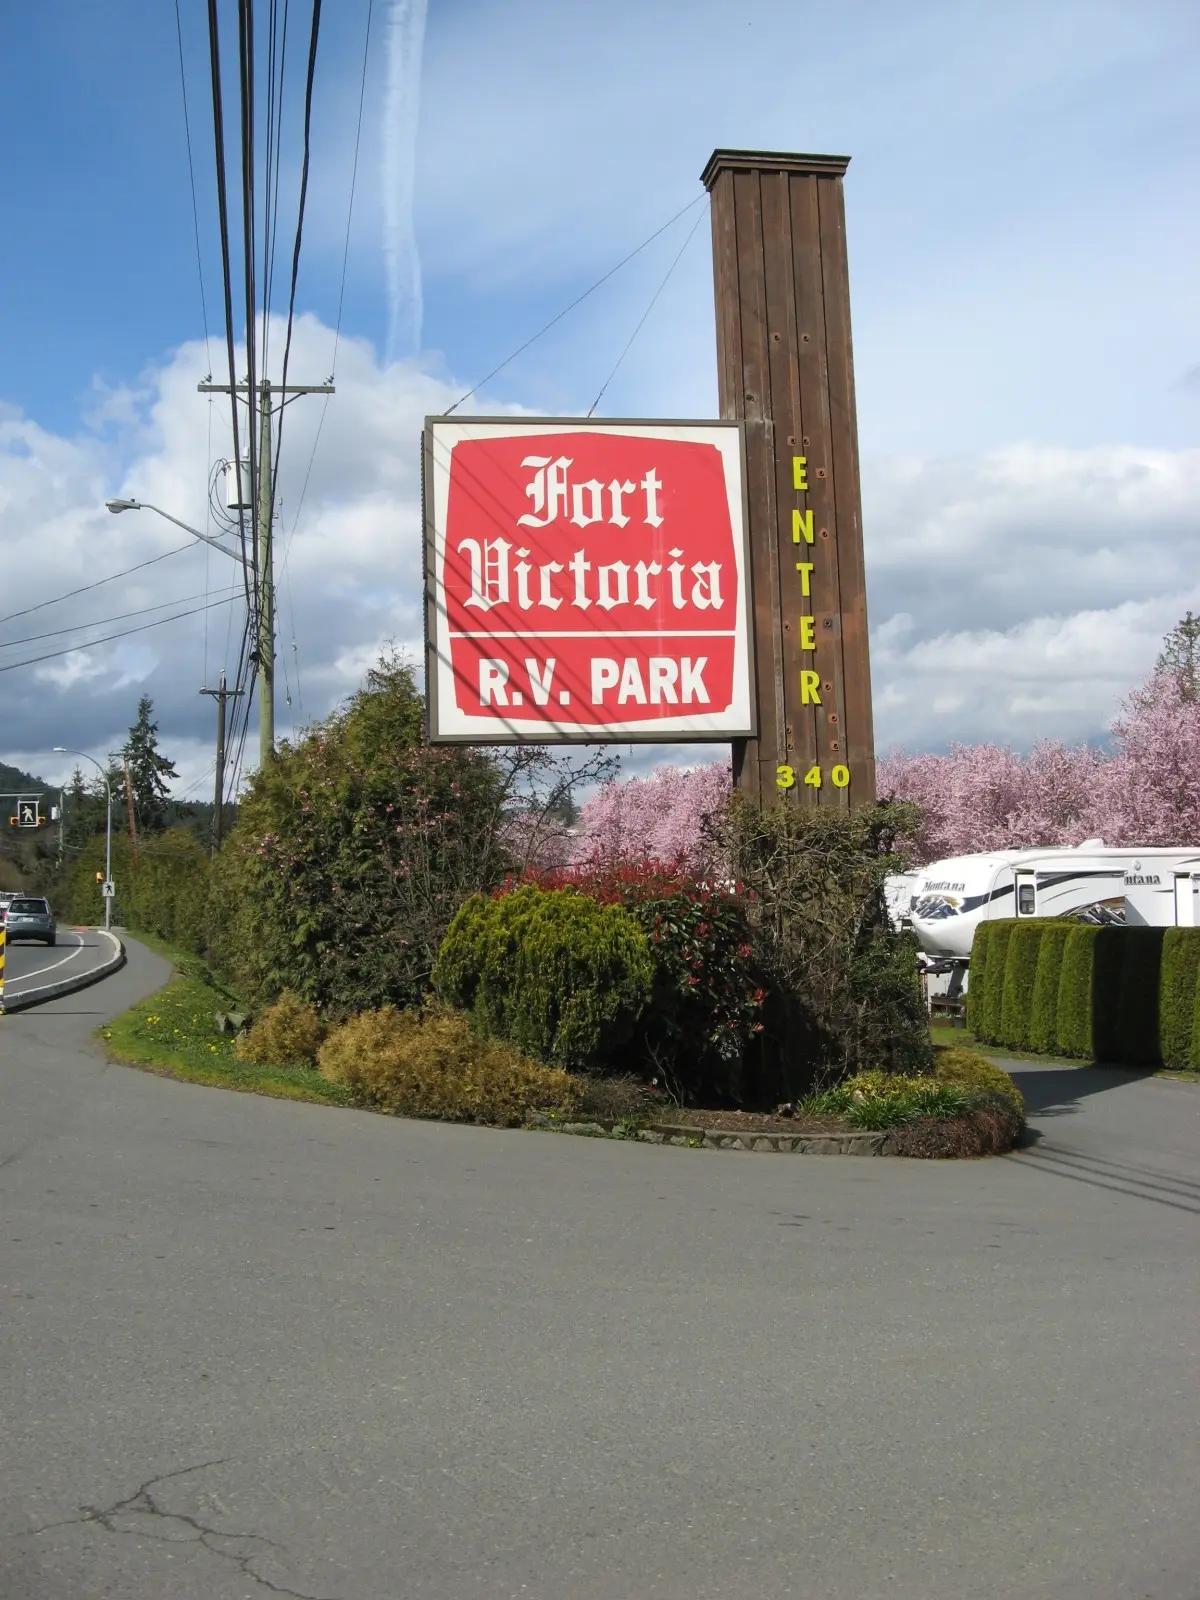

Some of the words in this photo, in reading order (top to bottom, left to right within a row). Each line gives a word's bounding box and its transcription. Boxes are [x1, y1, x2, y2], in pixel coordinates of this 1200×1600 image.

[516, 455, 665, 529] Fort
[457, 536, 725, 613] Victoria
[791, 456, 822, 705] ENTER
[478, 657, 570, 707] R.V.
[590, 656, 711, 705] PARK
[775, 764, 850, 790] 340
[922, 880, 966, 892] Montana
[1124, 873, 1161, 886] ntana
